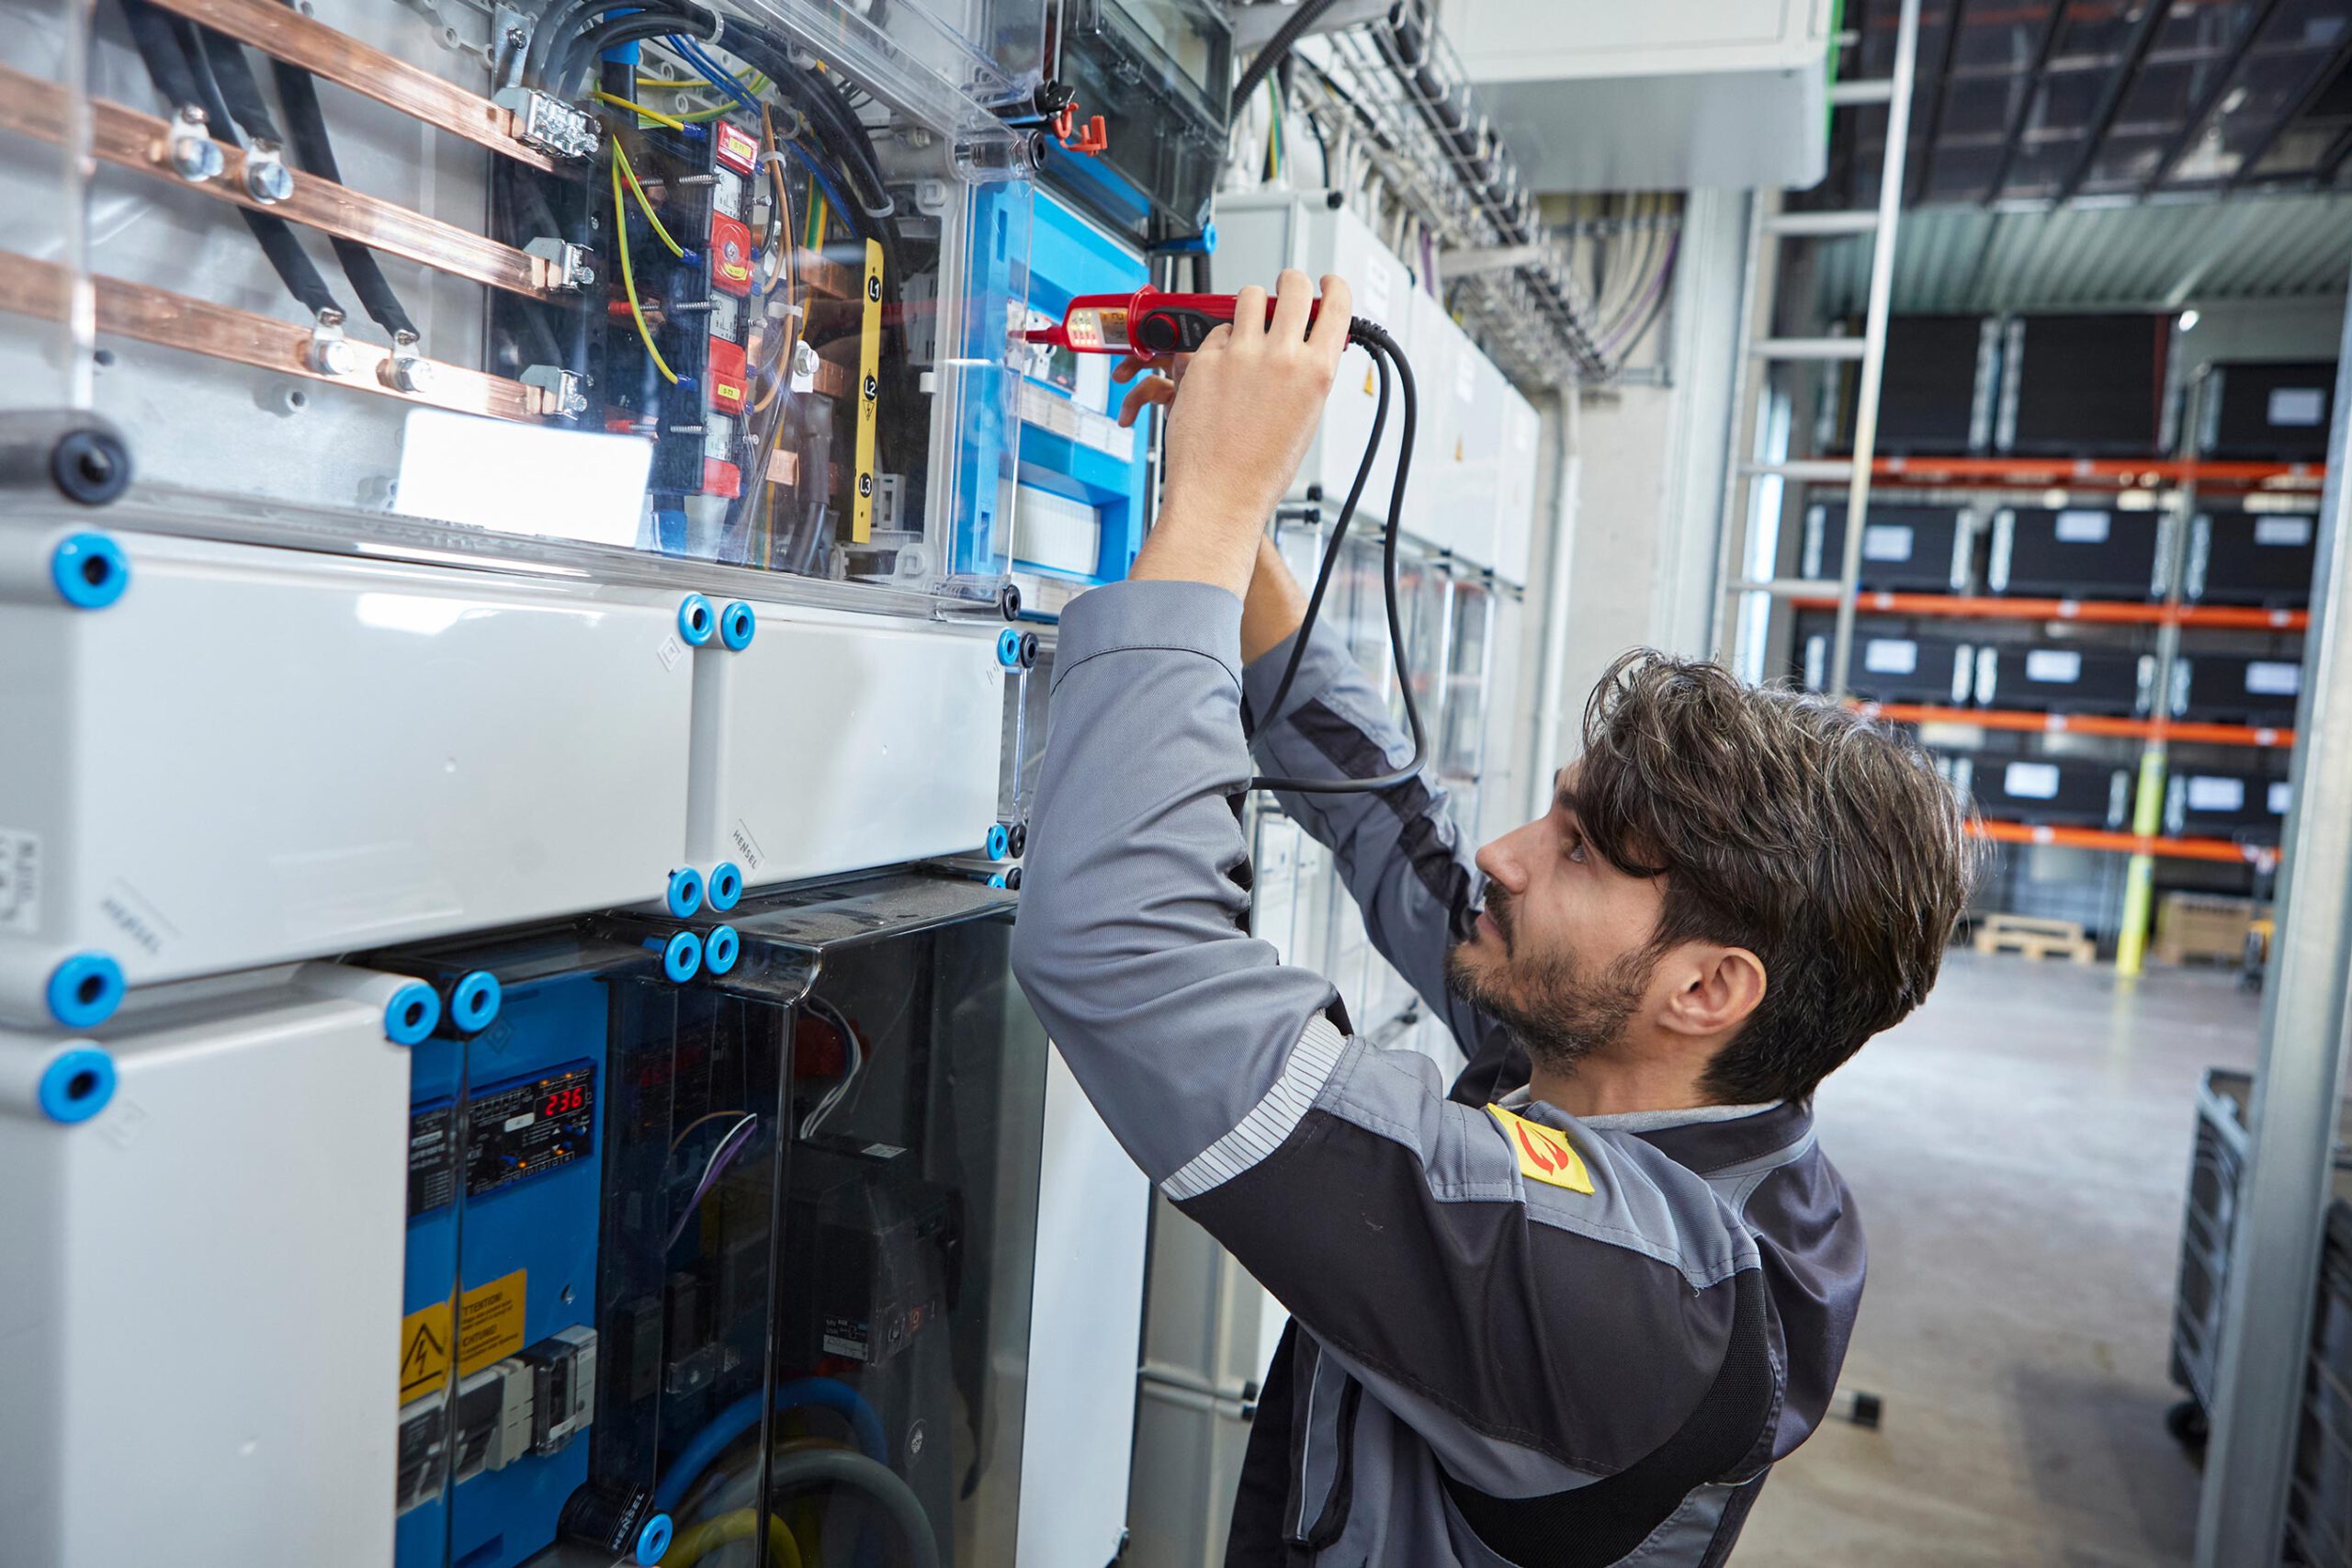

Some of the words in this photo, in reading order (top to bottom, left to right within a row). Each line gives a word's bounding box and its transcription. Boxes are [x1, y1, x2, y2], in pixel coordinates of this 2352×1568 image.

[869, 279, 879, 299] L1
[865, 378, 876, 397] L2
[860, 477, 871, 494] L3
[732, 829, 758, 870] HENSEL
[545, 1087, 582, 1117] 236
[612, 1493, 644, 1551] HENSEL
